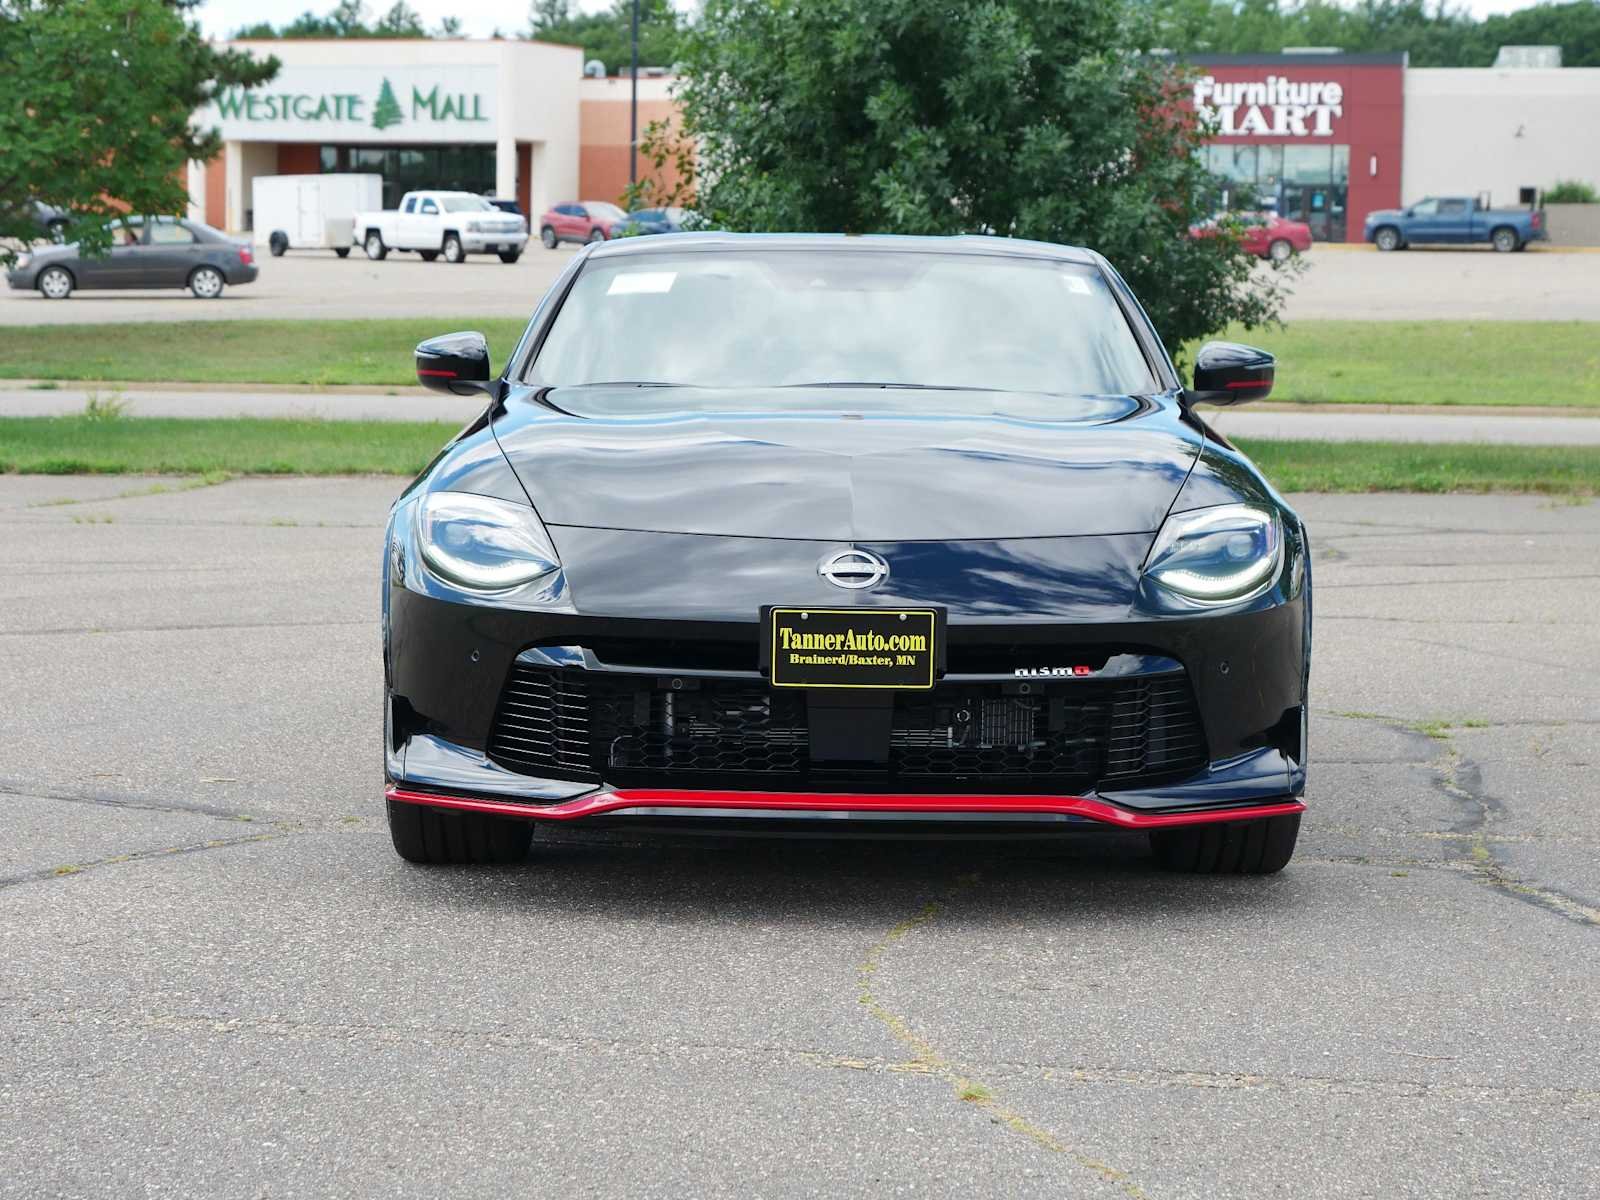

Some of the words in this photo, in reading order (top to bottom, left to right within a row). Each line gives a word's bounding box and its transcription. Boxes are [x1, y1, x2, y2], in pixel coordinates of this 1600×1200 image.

[1193, 75, 1343, 104] Furniture
[780, 627, 926, 651] TannerAuto.com
[789, 654, 893, 667] Brainerd/Baxter,
[896, 655, 915, 666] MN
[1014, 665, 1089, 677] nismo
